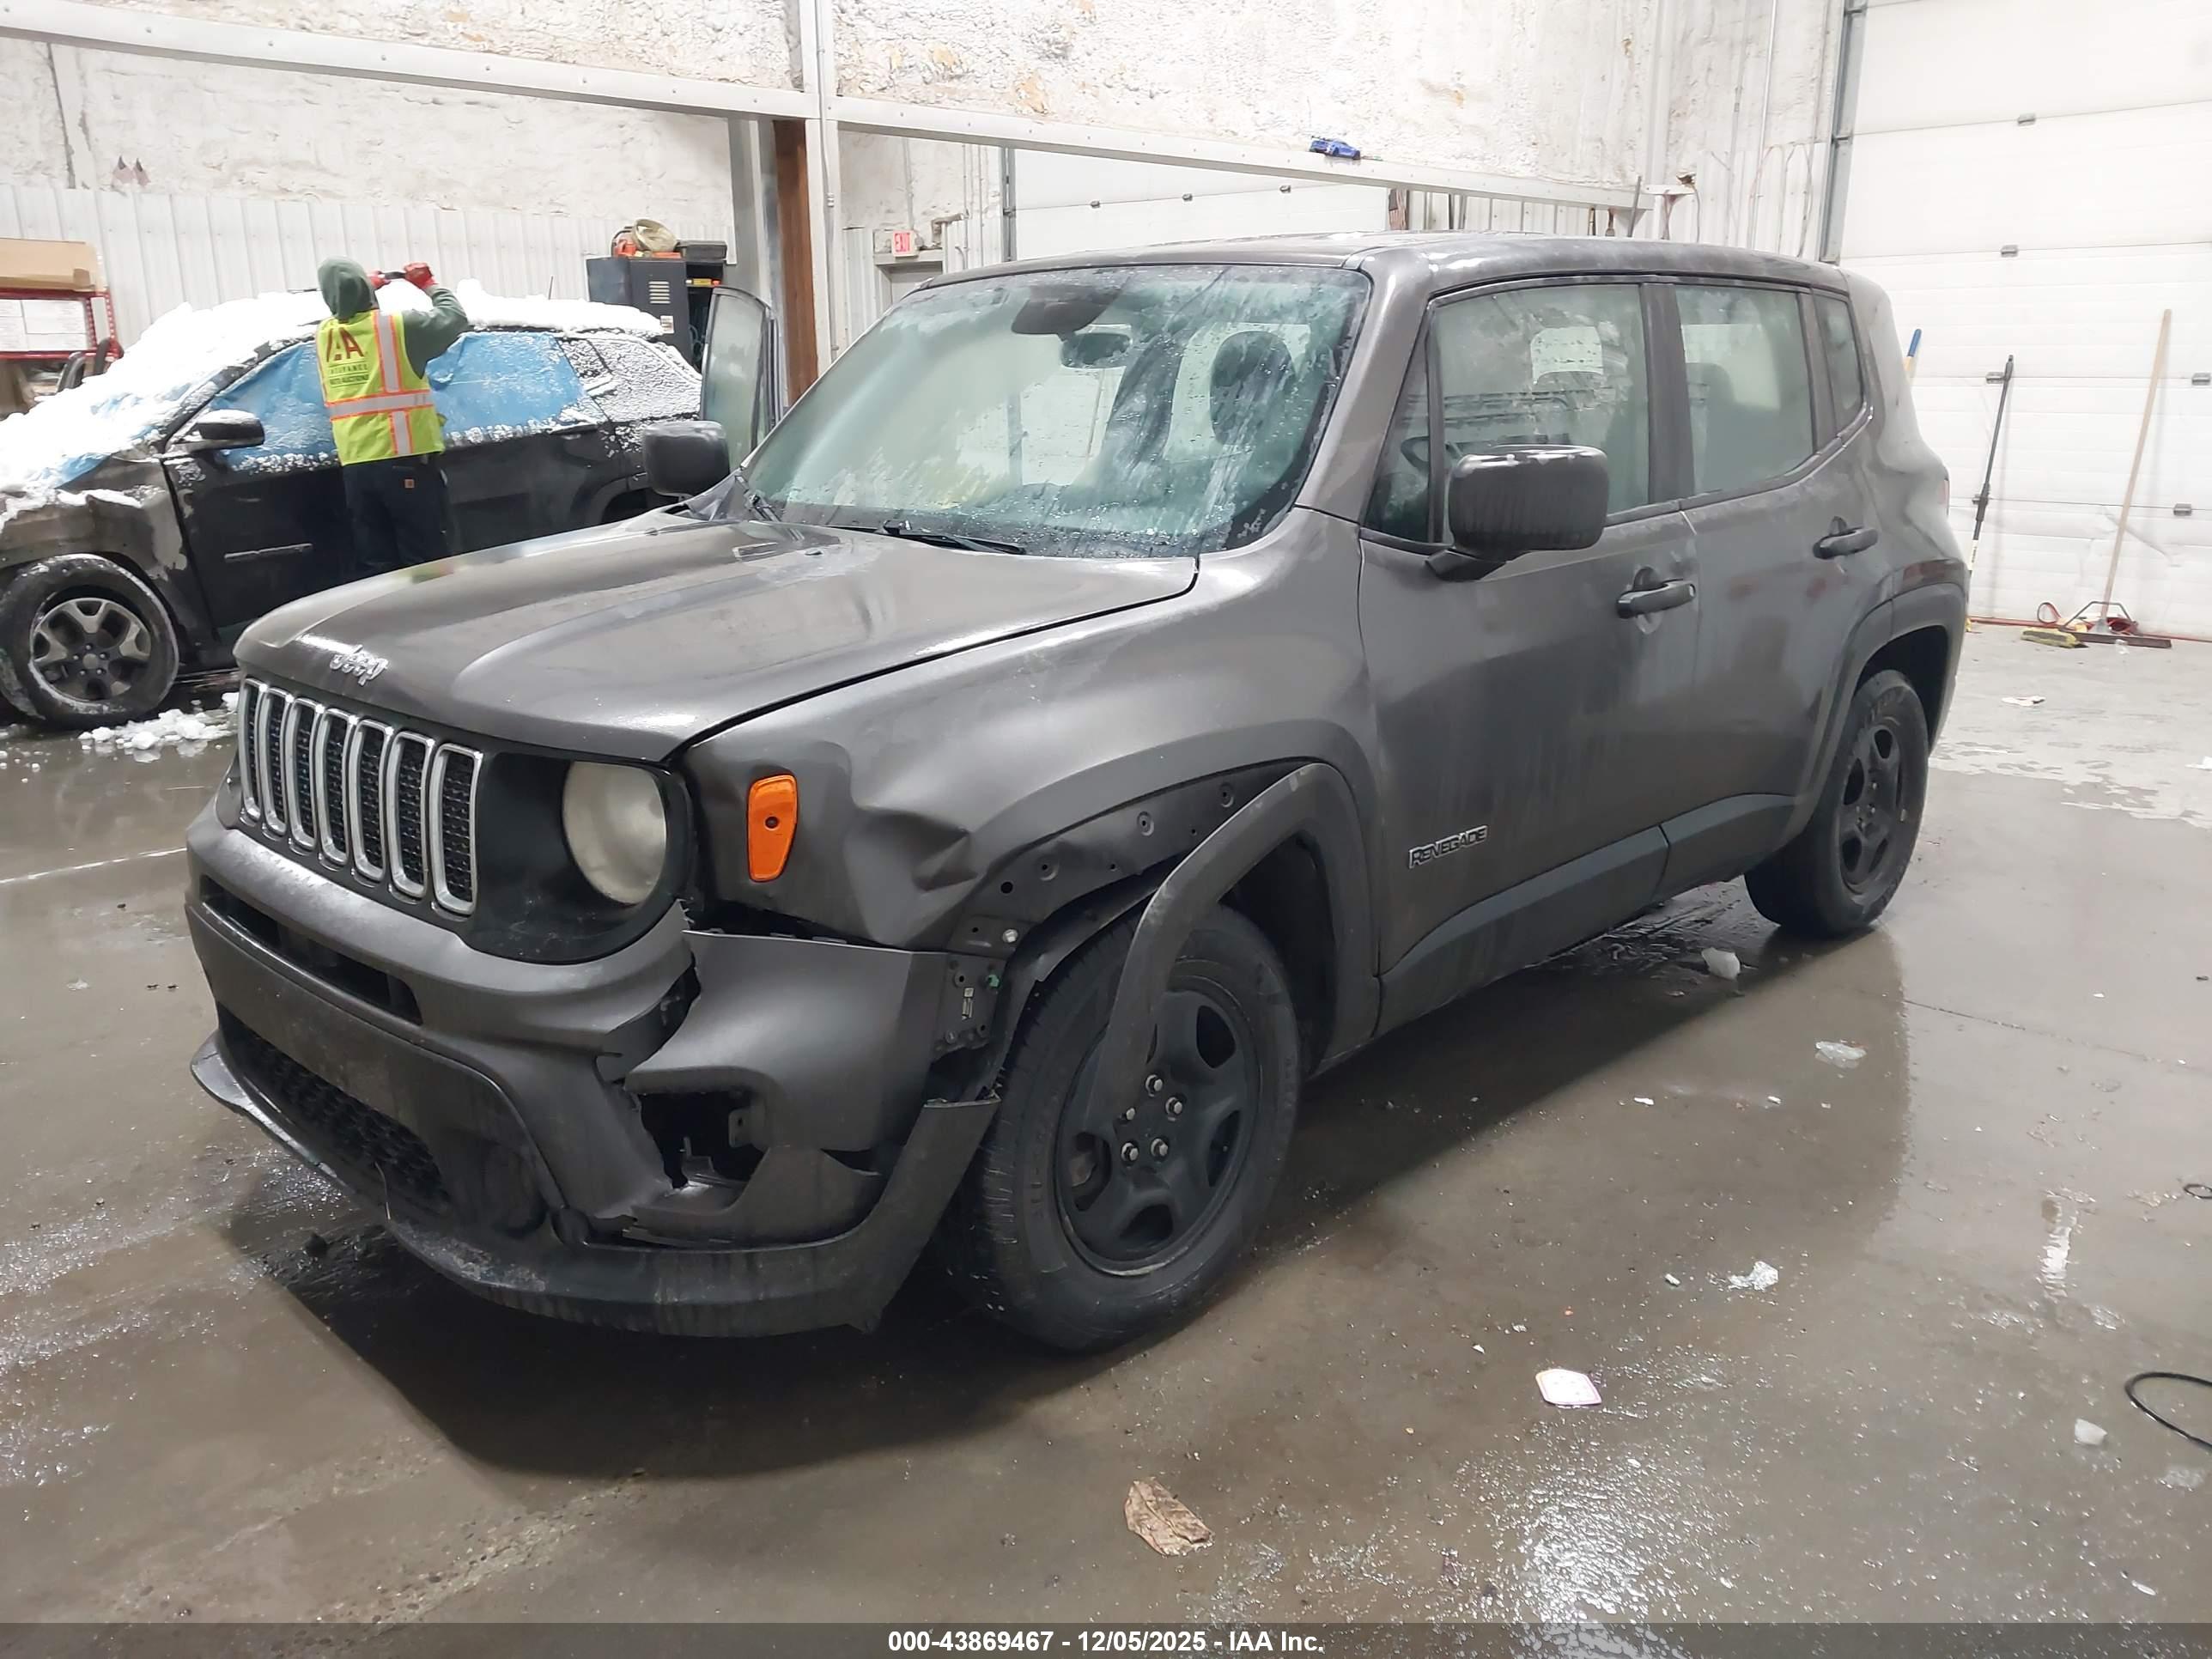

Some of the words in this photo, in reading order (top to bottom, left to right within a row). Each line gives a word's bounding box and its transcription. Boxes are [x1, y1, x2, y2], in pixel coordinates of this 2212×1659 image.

[895, 233, 910, 252] EXIT
[330, 645, 389, 687] Jeep
[1408, 824, 1487, 869] RENEGADE
